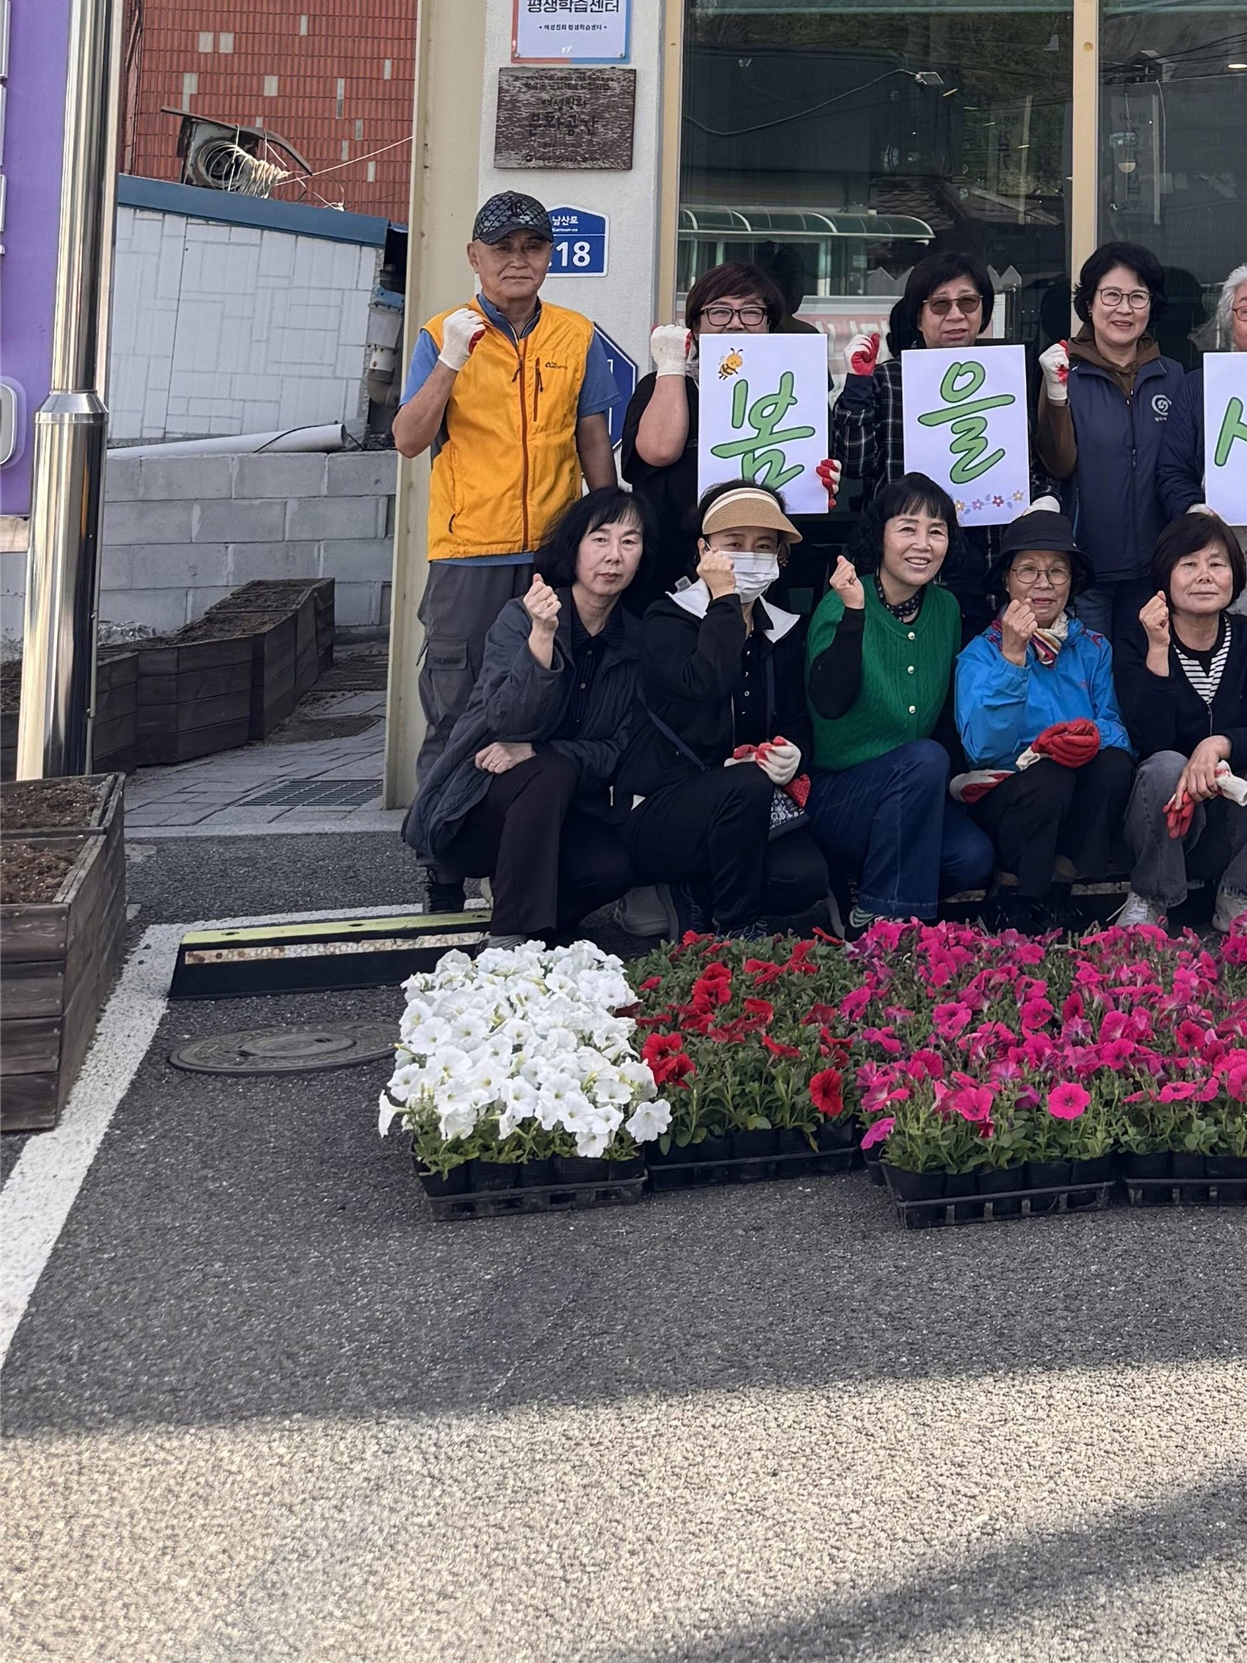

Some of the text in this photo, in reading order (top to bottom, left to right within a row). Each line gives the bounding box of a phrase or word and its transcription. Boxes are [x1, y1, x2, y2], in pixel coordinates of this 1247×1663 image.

[548, 241, 591, 267] 18
[552, 215, 579, 226] 남산로
[710, 371, 816, 490] 봄
[917, 360, 1016, 484] 을
